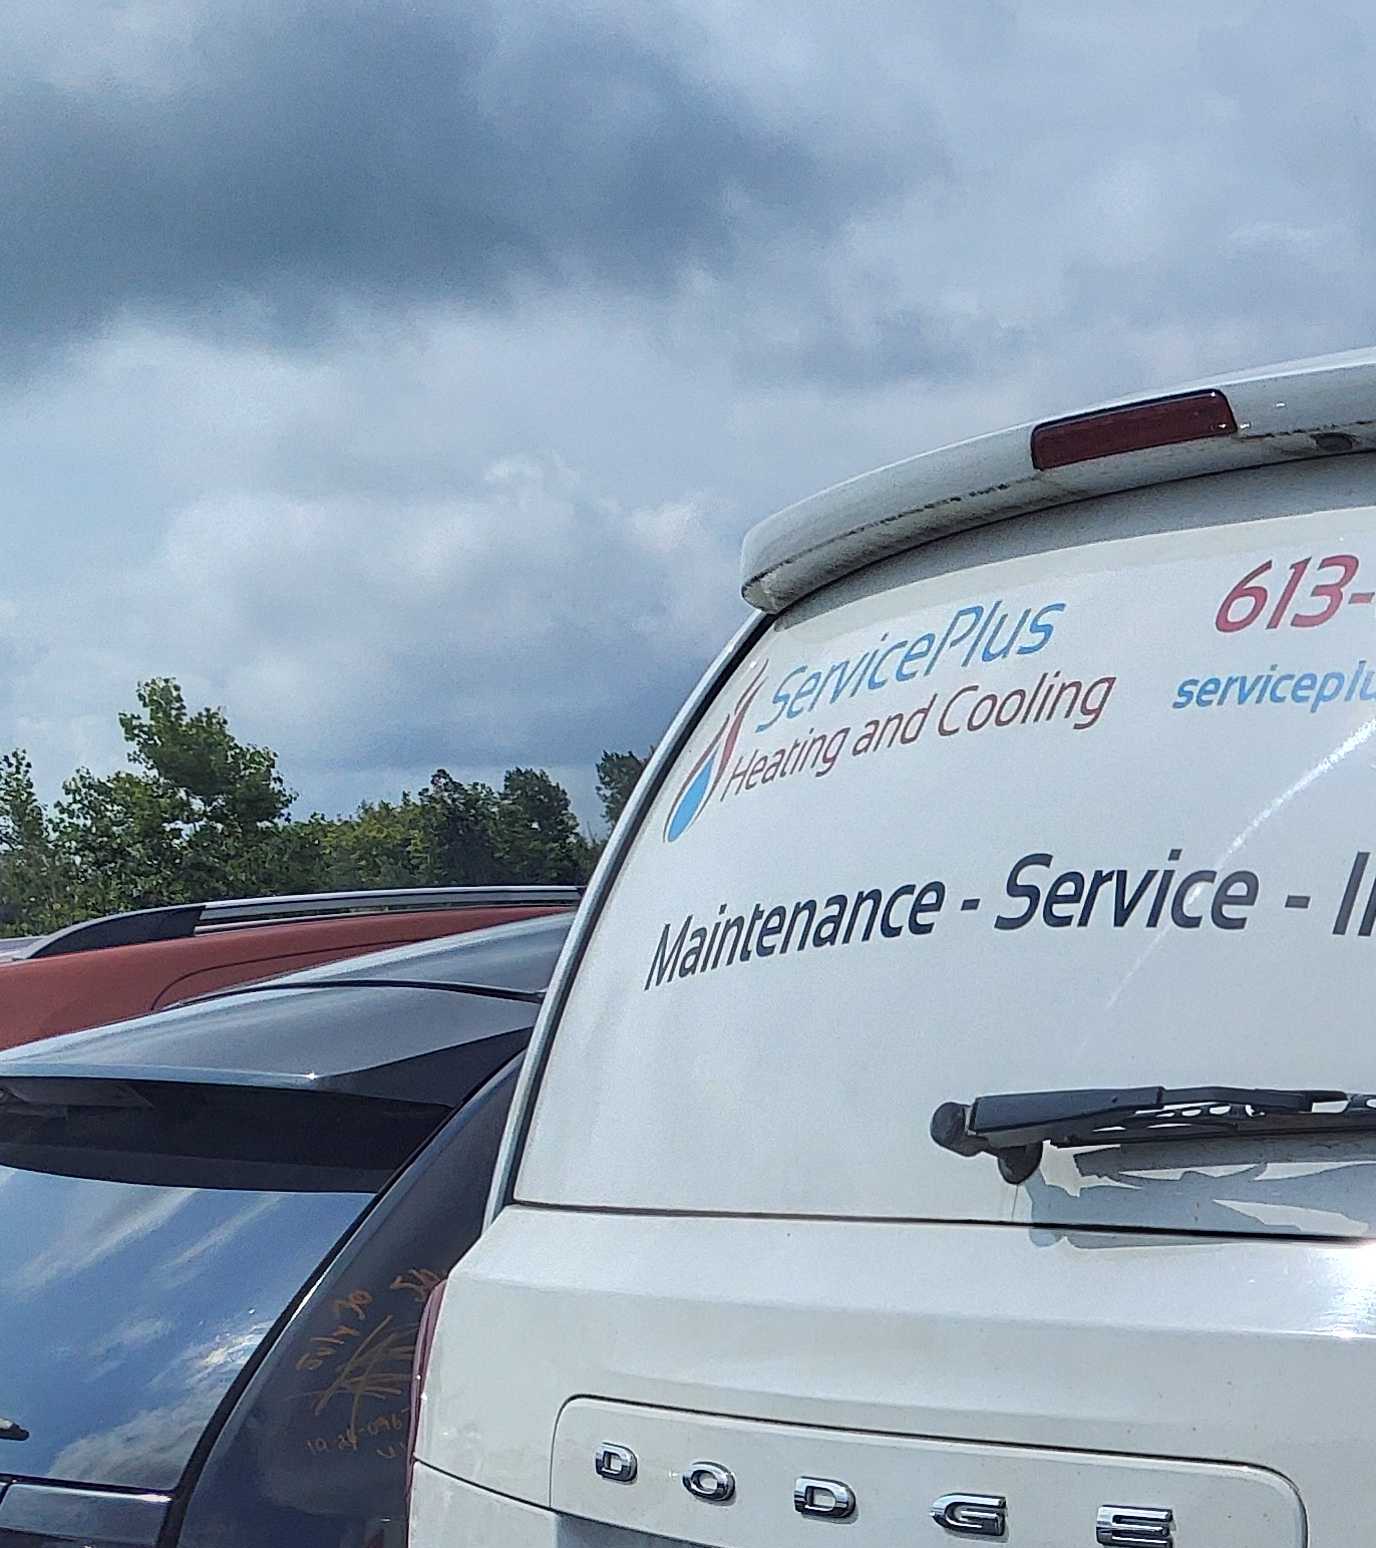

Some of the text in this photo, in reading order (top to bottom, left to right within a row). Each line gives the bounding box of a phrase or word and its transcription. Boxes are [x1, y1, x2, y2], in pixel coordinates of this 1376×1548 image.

[756, 600, 1065, 733] ServicePlus
[720, 672, 1116, 802] Heating and Cooling
[643, 880, 946, 991] Maintenance
[994, 848, 1259, 931] Service
